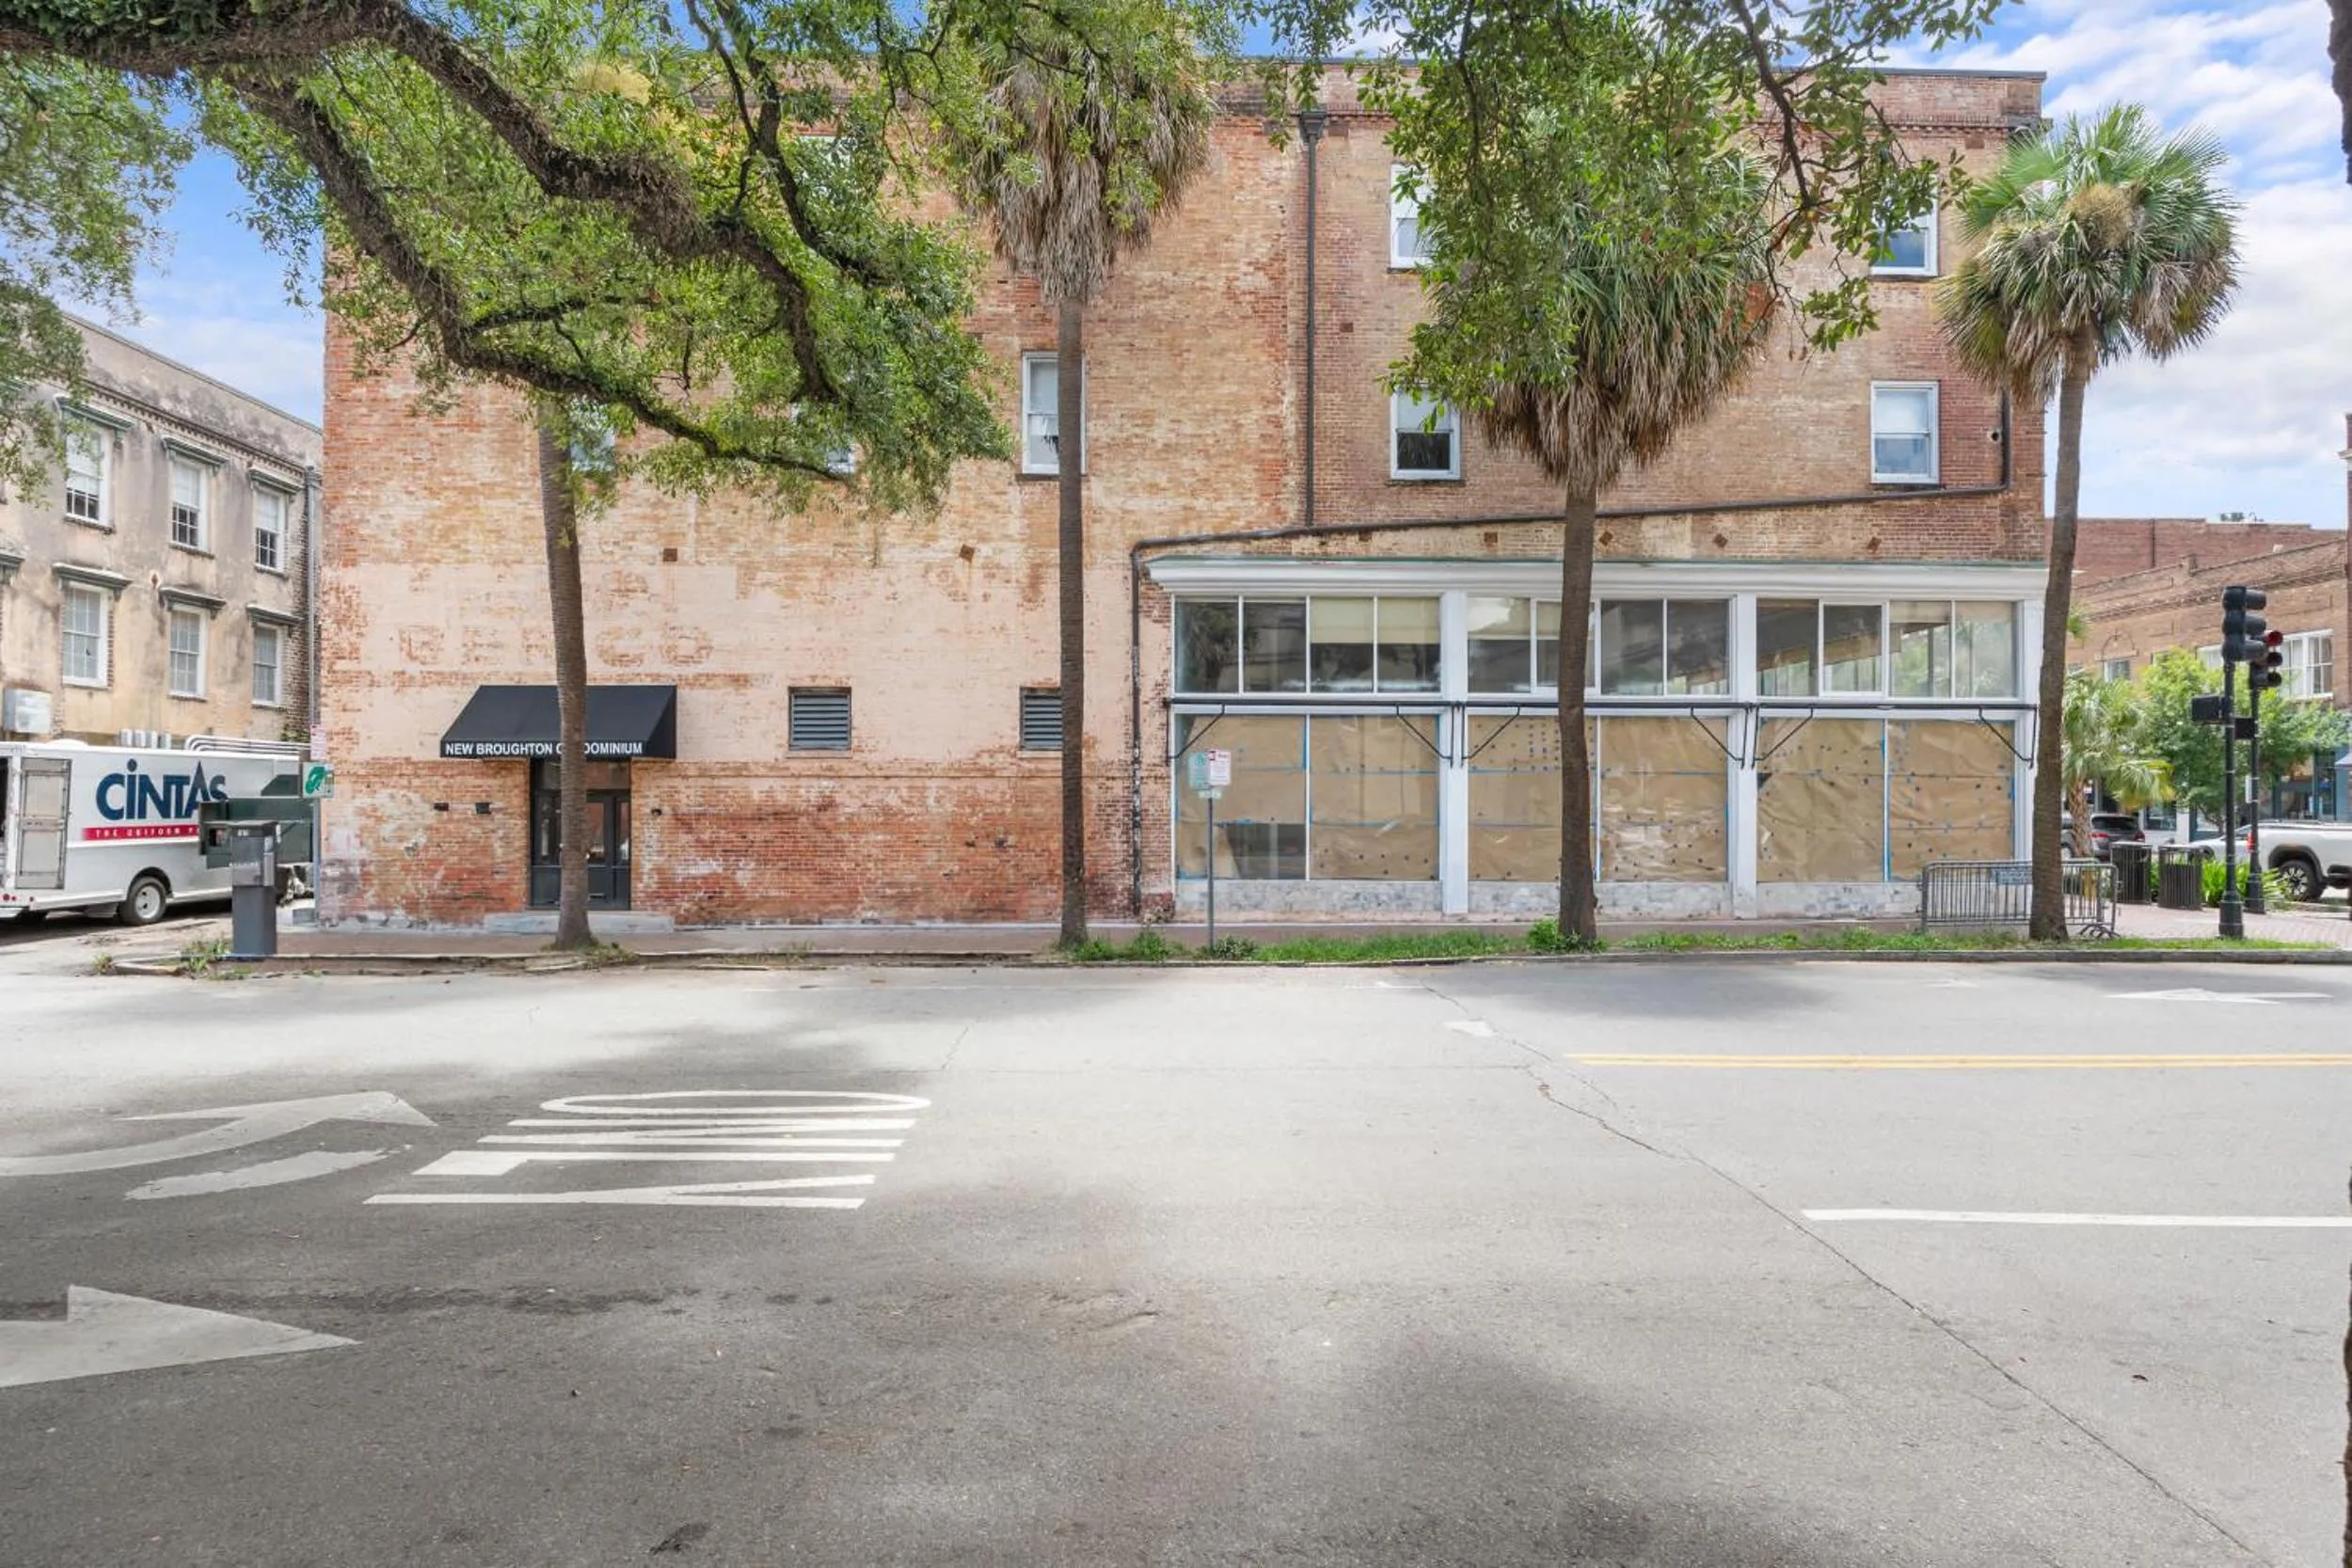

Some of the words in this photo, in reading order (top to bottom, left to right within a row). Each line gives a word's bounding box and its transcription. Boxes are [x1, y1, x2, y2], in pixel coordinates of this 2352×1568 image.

[446, 742, 474, 755] NEW
[476, 742, 553, 755] BROUGHTON
[556, 741, 643, 754] CDOMINIUM
[362, 1090, 931, 1209] ONLY
